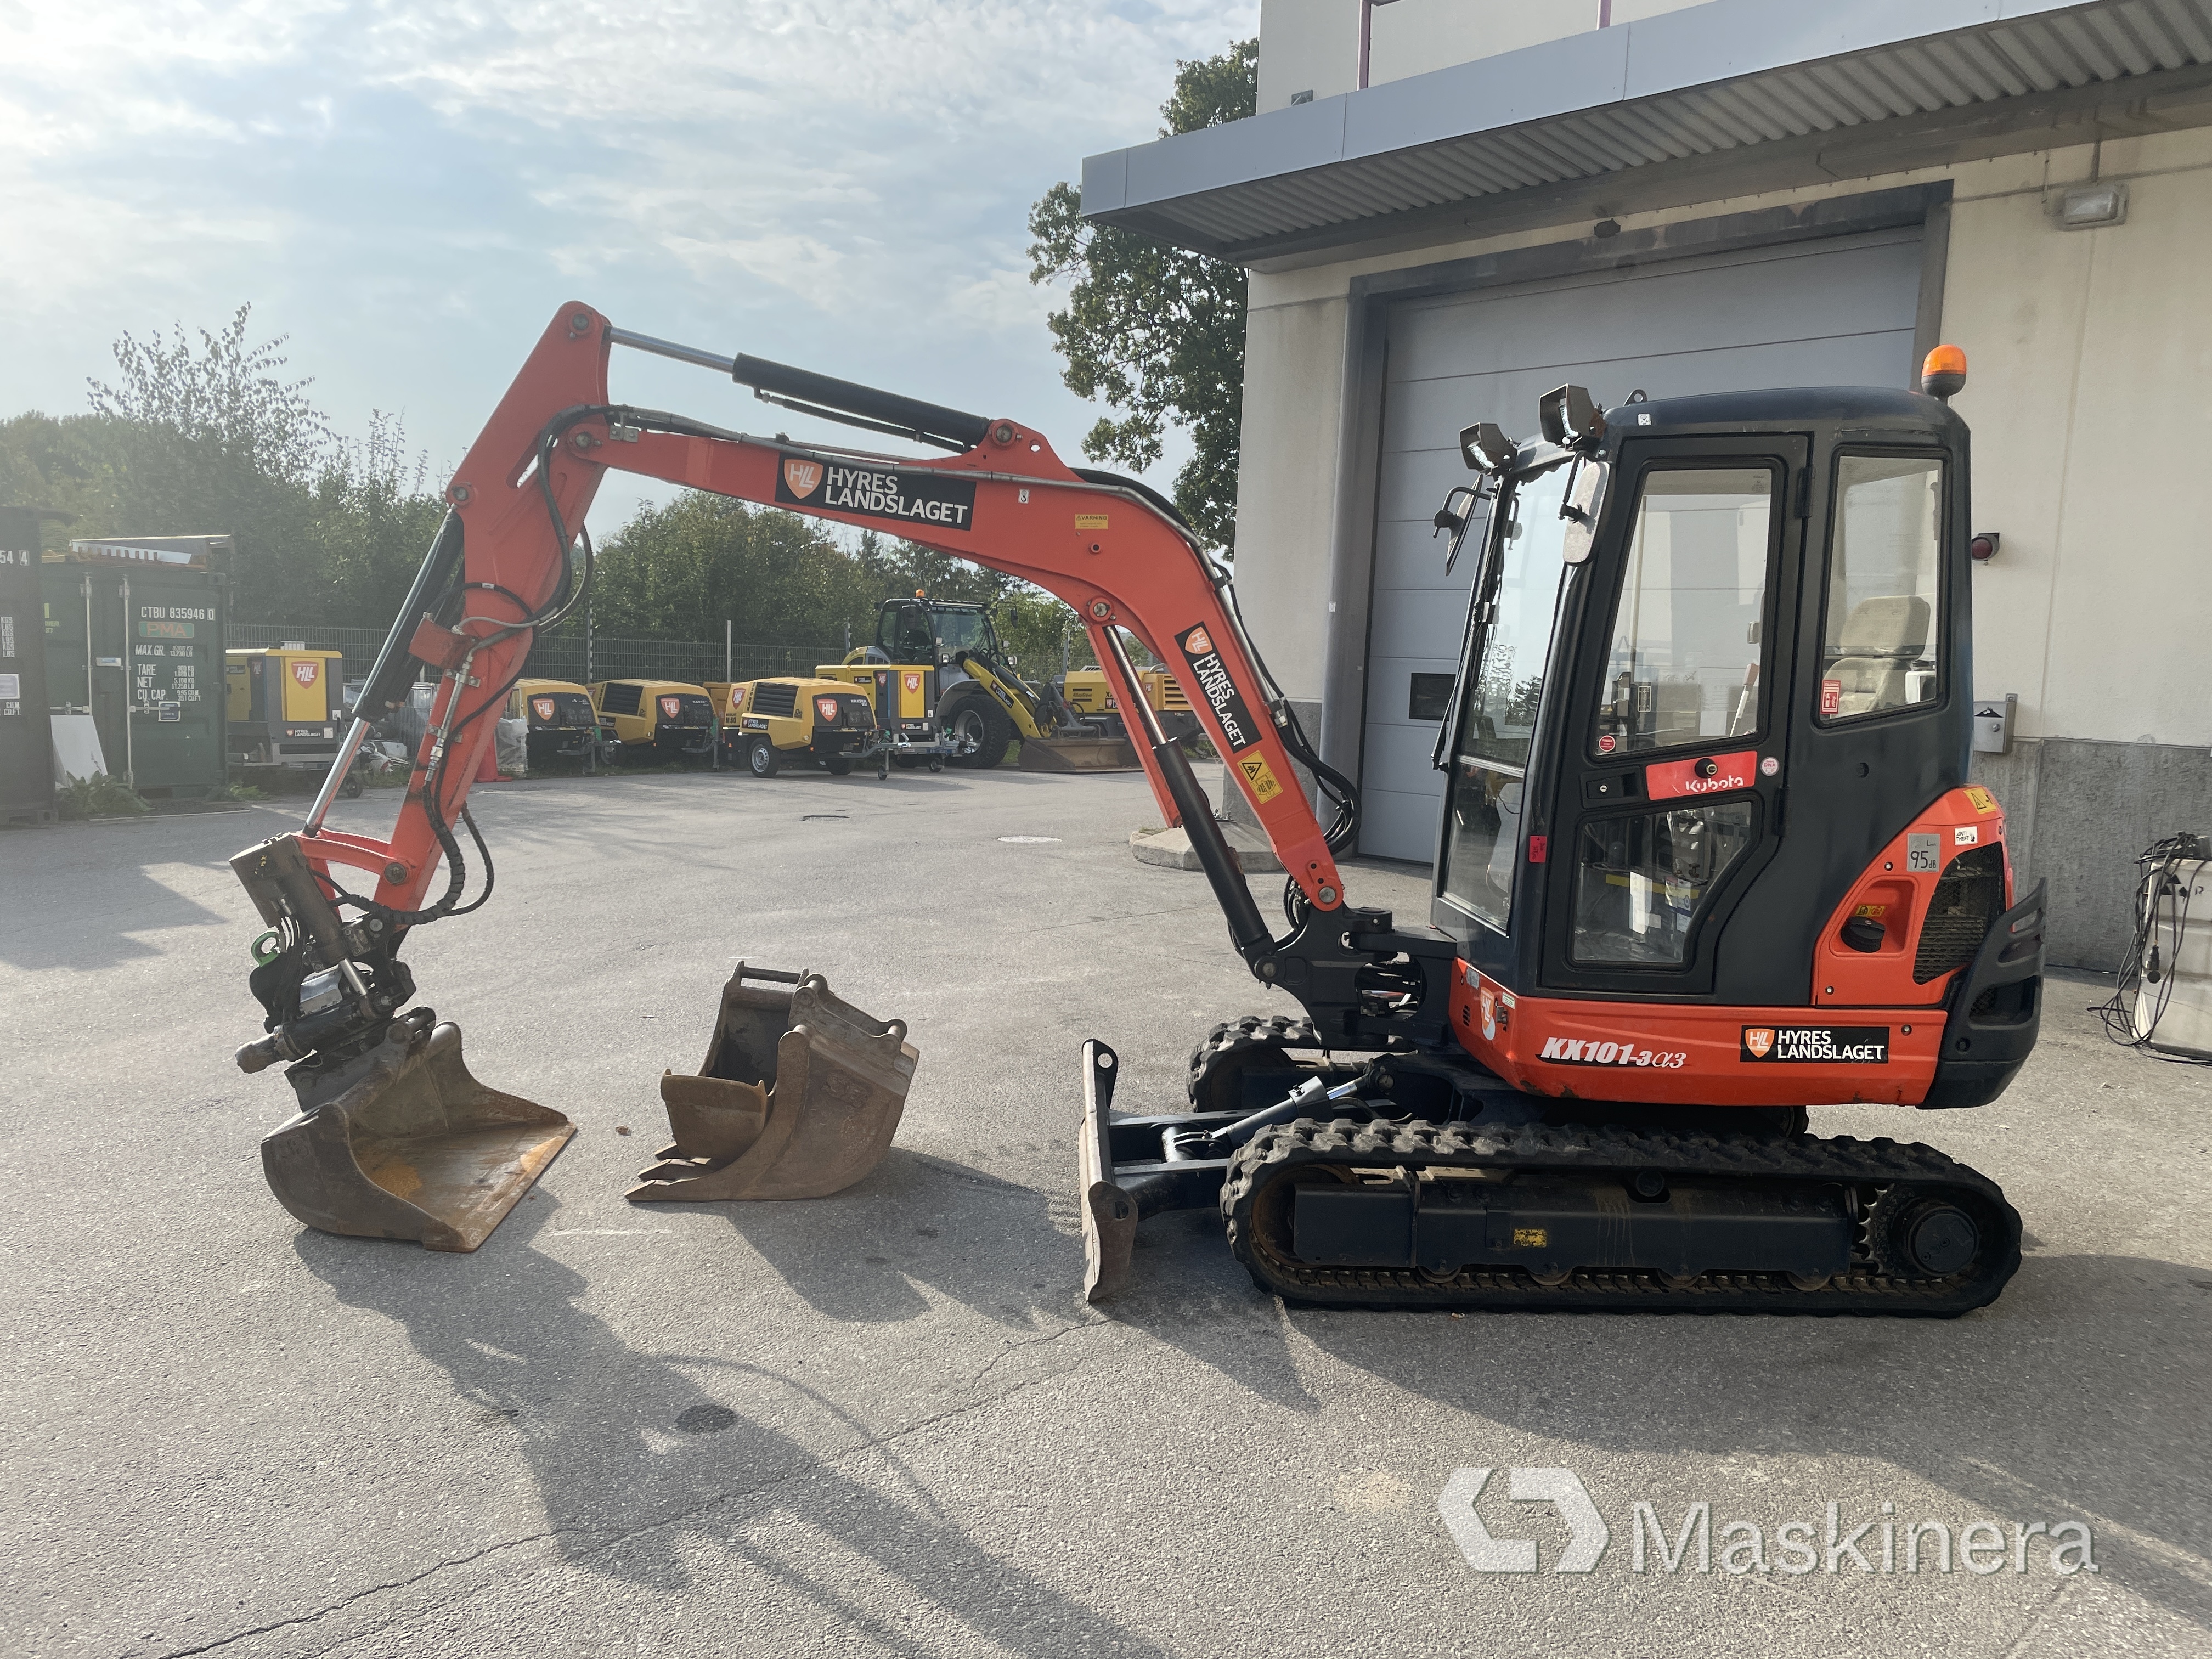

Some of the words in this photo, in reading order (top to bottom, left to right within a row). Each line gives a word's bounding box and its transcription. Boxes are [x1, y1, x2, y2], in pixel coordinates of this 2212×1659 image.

[827, 466, 898, 494] HYRES
[825, 486, 968, 523] LANDSLAGET
[141, 606, 165, 618] CTBU
[170, 607, 205, 619] 835946
[146, 623, 187, 636] PMA
[137, 664, 156, 675] TARE
[1205, 653, 1234, 699] HYRES
[137, 677, 153, 687] NET
[1193, 659, 1246, 746] LANDSLAGET
[1685, 775, 1743, 792] Kubota
[1910, 851, 1928, 868] 95
[1929, 860, 1936, 868] dB
[1778, 1030, 1831, 1045] HYRES
[1778, 1044, 1884, 1059] LANDSLAGET
